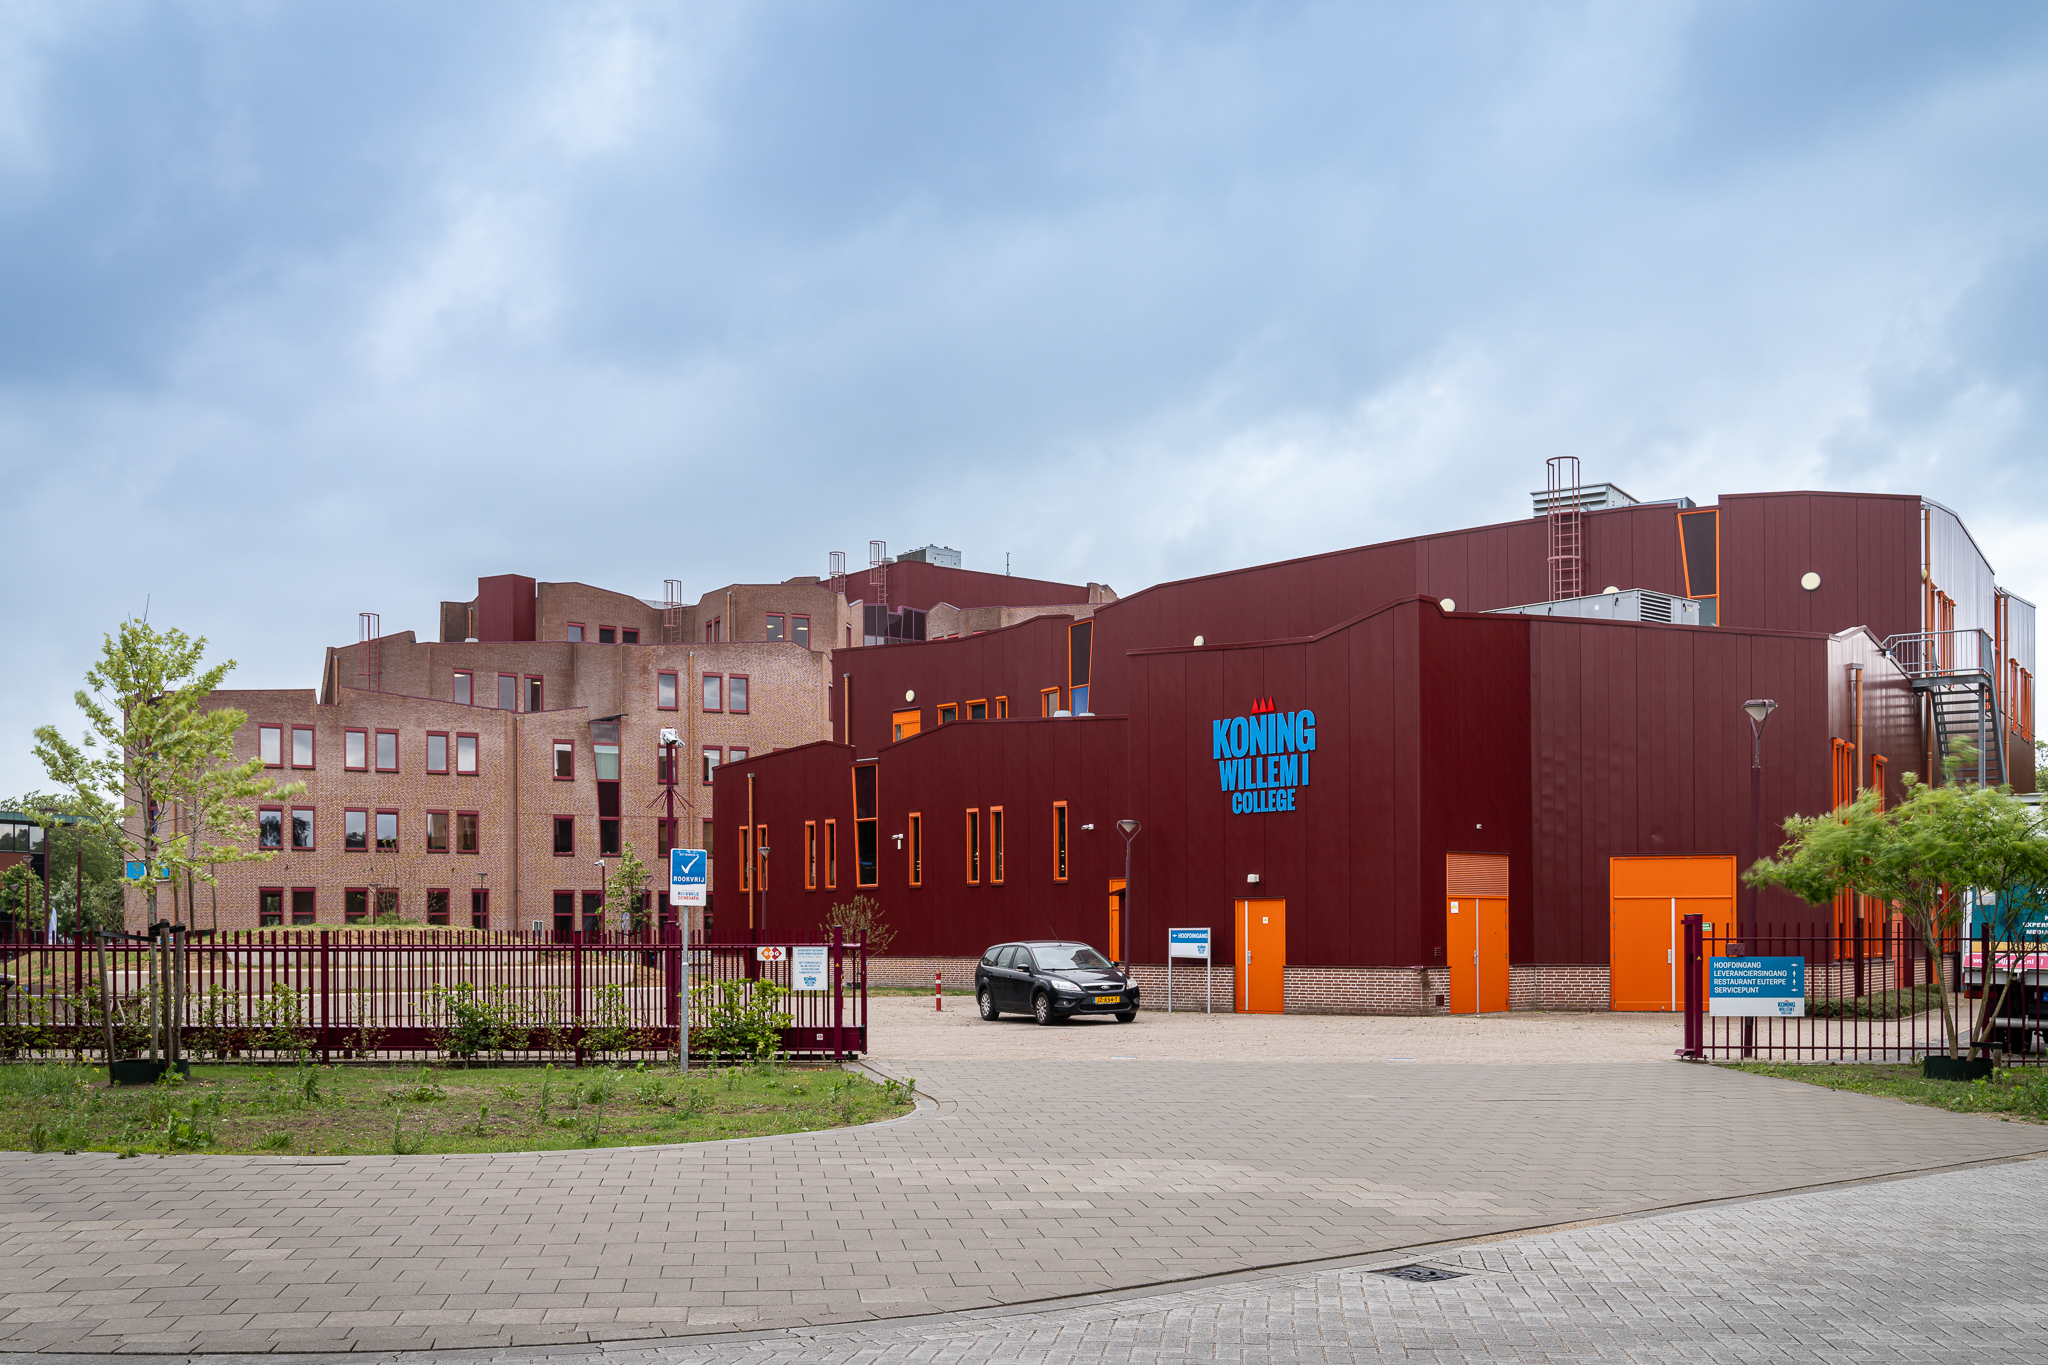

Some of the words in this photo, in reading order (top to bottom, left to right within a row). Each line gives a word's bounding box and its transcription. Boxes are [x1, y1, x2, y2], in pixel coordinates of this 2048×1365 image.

[1213, 709, 1315, 759] KONING
[1219, 754, 1298, 791] WILLEM
[1302, 753, 1309, 786] I
[1232, 788, 1295, 814] COLLEGE
